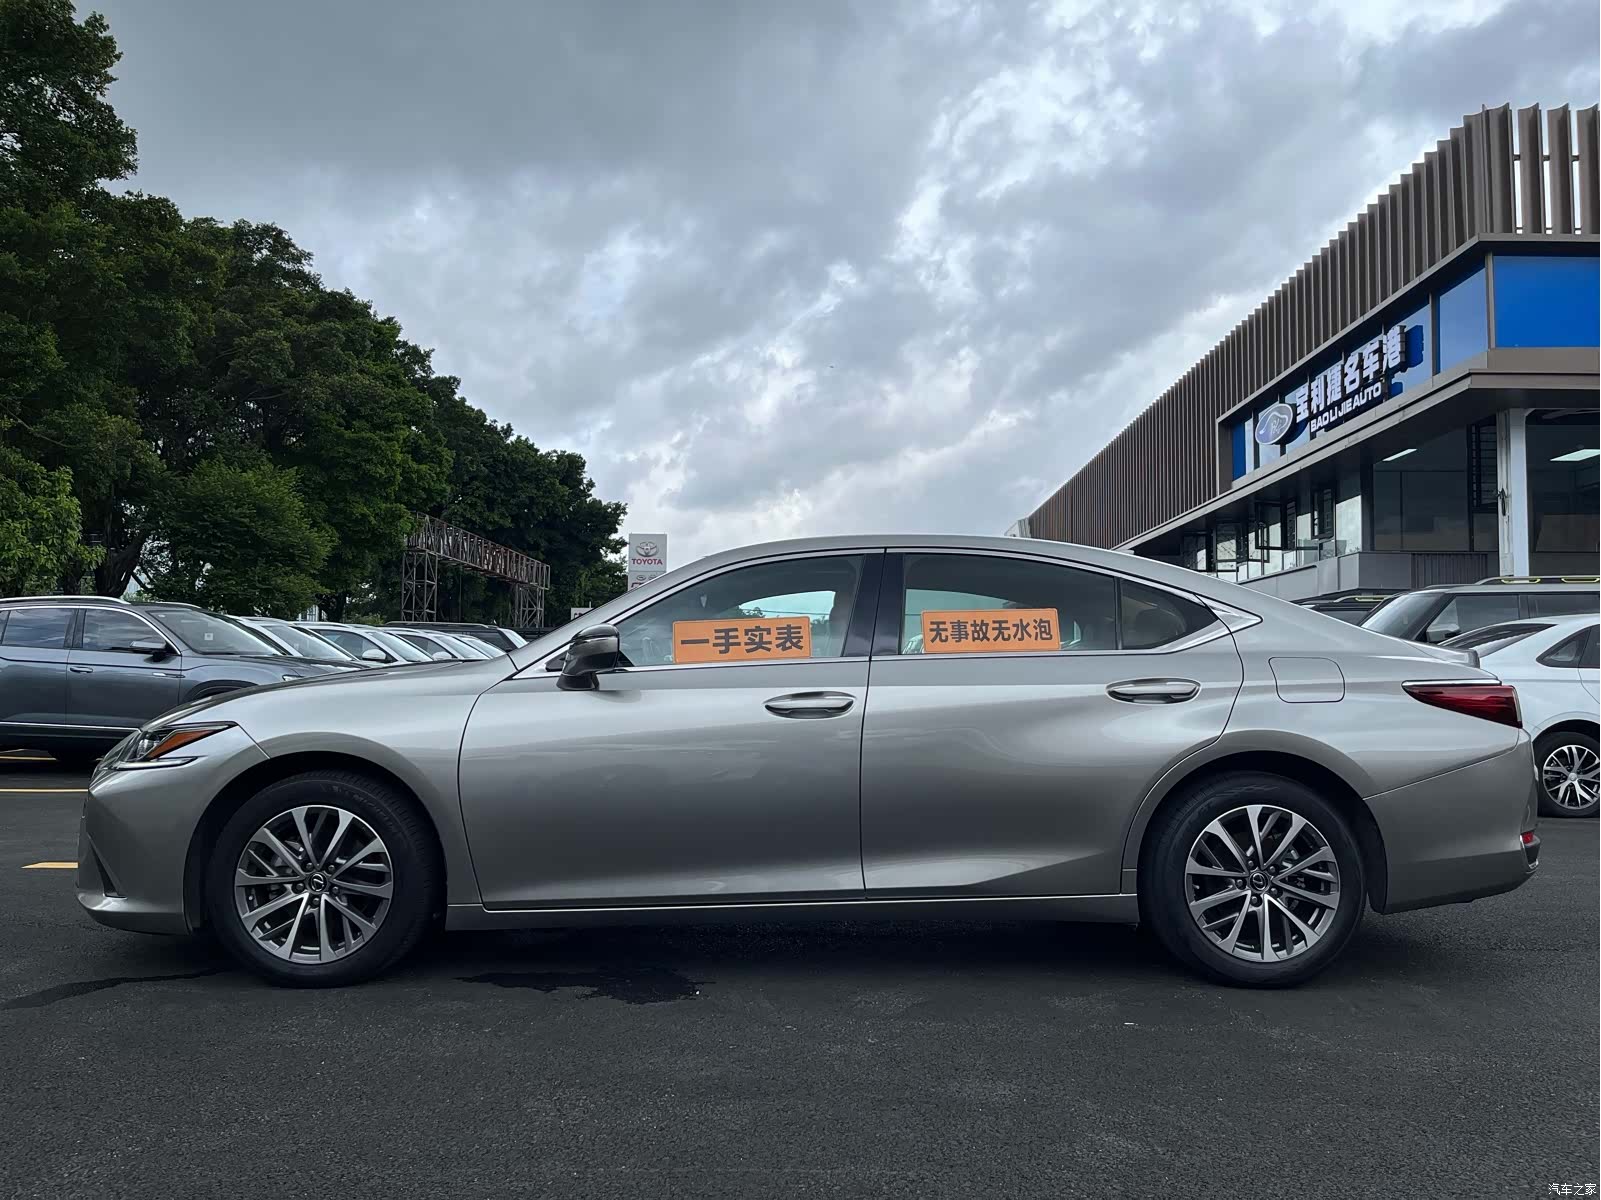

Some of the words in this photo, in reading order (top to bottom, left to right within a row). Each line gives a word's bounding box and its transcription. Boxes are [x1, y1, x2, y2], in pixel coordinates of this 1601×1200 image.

[1295, 325, 1401, 423] 宝利捷名车港
[631, 558, 663, 566] TOYOTA
[680, 623, 804, 655] 一手实表
[929, 618, 1053, 643] 无事故无水泡
